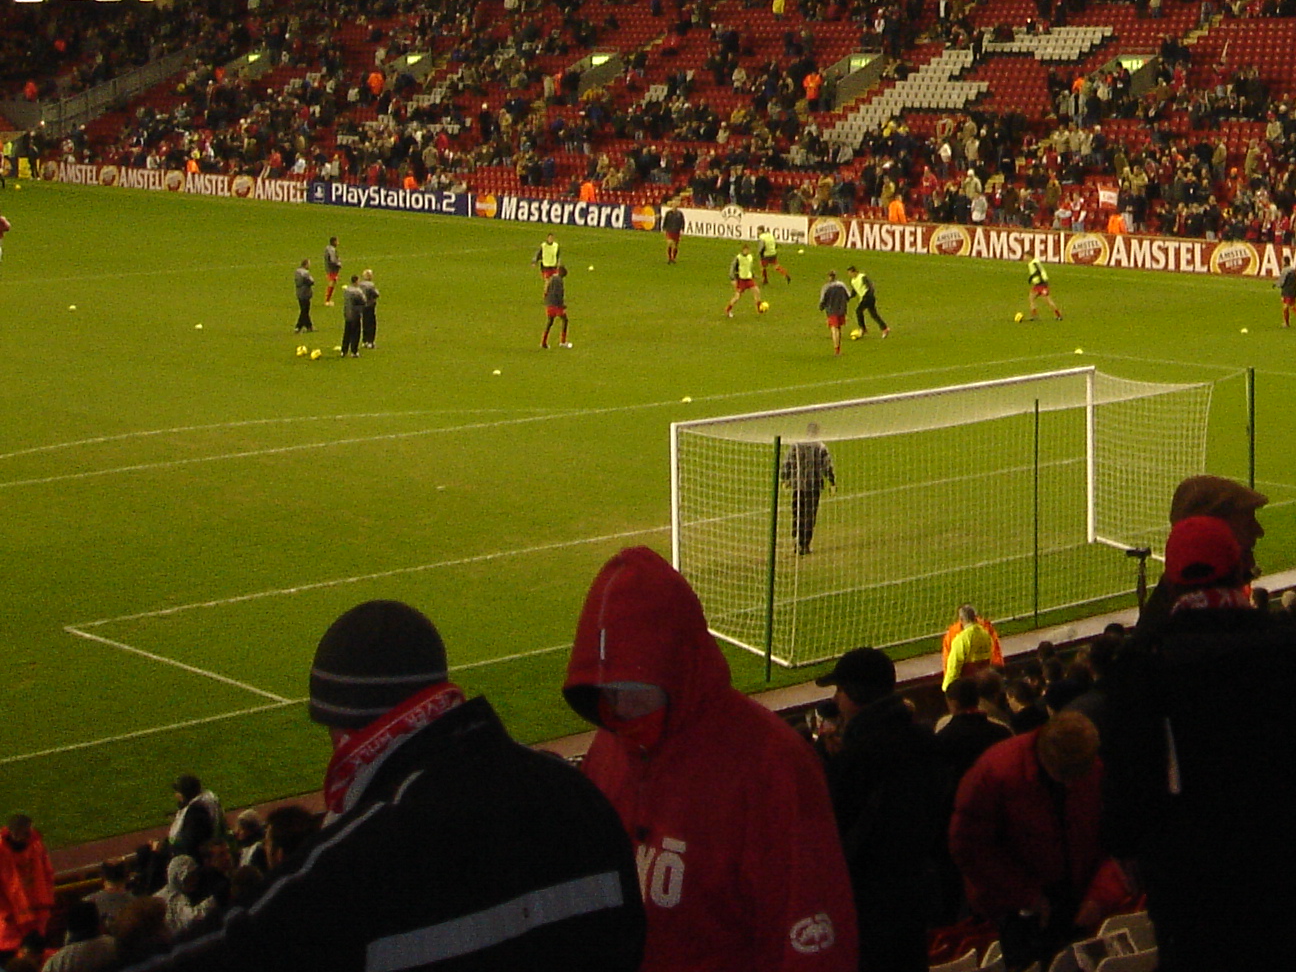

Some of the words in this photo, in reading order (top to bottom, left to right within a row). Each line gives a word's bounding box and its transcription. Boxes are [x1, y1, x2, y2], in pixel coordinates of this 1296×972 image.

[59, 160, 99, 185] AMSTEL
[119, 165, 162, 190] AMSTEL
[185, 171, 231, 196] AMSTEL
[255, 177, 304, 202] AMSTEL
[501, 196, 625, 228] MasterCard
[686, 220, 742, 238] AMPIONS
[847, 220, 927, 254] AMSTEL
[971, 228, 1060, 263] AMSTEL
[1109, 235, 1209, 273] AMSTEL
